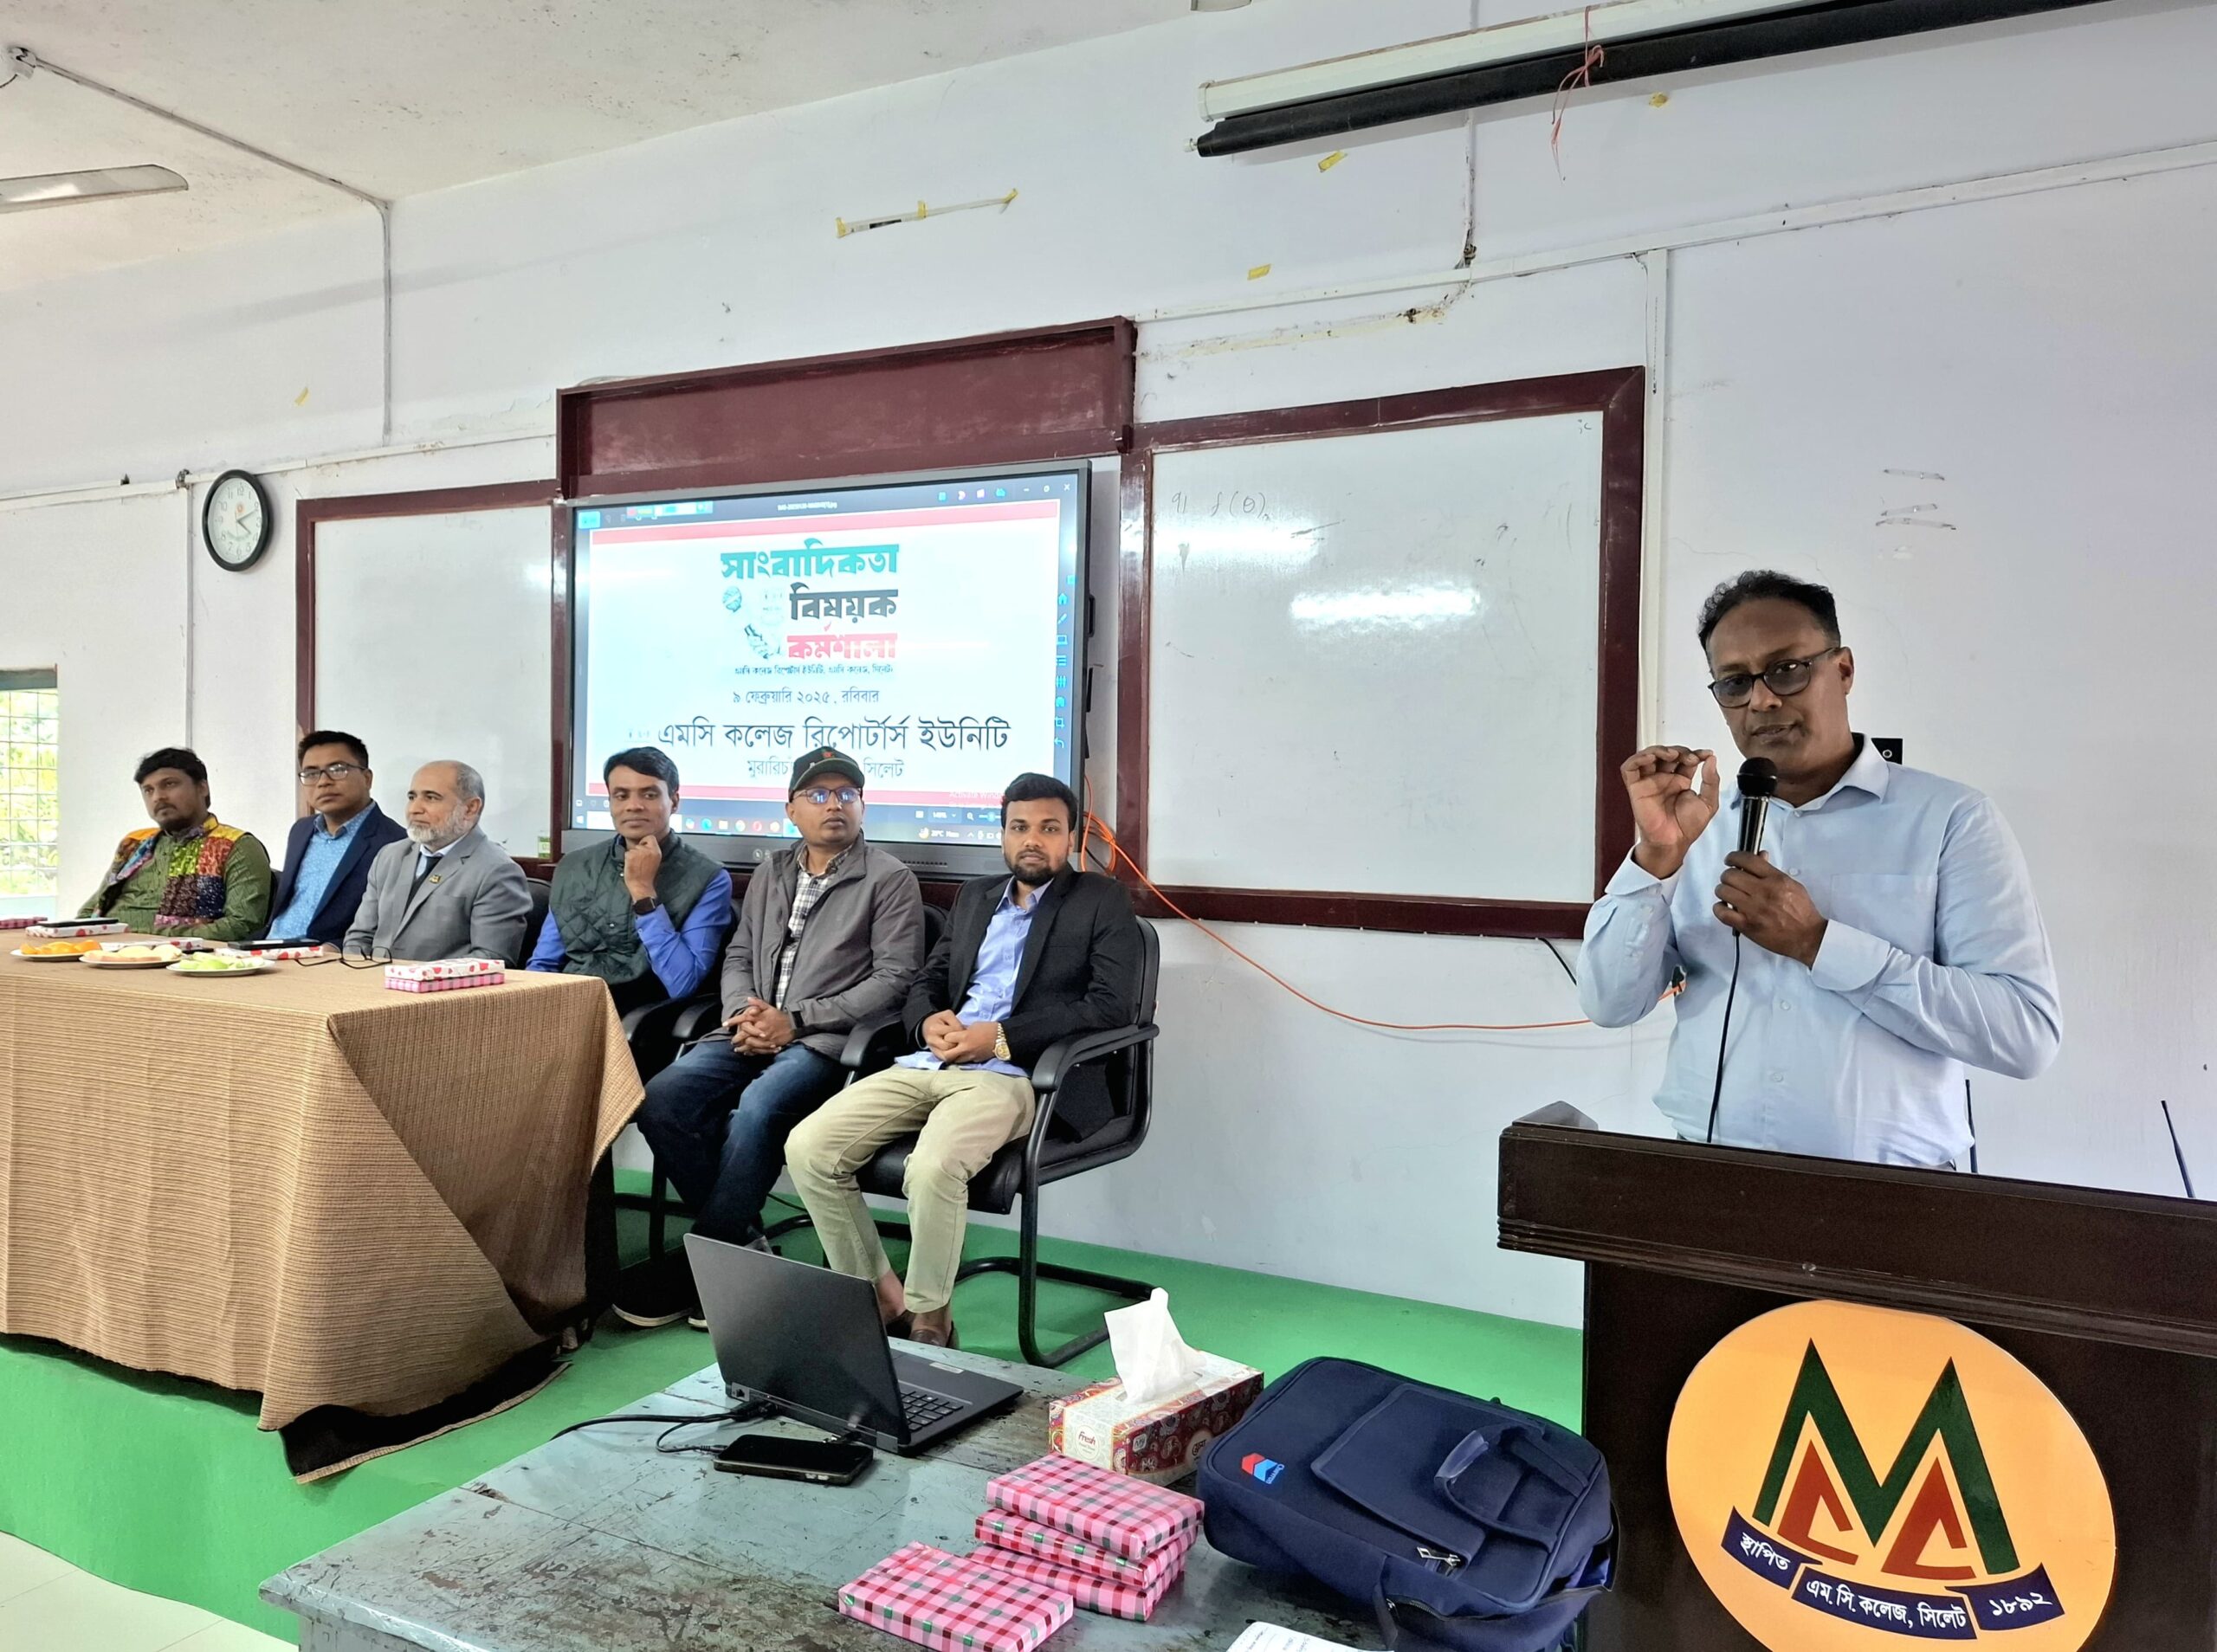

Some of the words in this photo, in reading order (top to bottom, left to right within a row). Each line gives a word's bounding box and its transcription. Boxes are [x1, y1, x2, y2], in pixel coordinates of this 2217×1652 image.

[721, 538, 899, 579] সাংবাদিকতা
[789, 581, 898, 623] বিষয়ক
[786, 622, 897, 659] কর্মশালা
[841, 686, 880, 703] রবিবার
[658, 716, 715, 748] এমসি
[722, 724, 795, 749] কলেজ
[803, 714, 911, 750] রিপোর্টার্স
[917, 716, 1012, 752] ইউনিটি
[863, 756, 904, 778] সিলেট
[1078, 1430, 1096, 1446] Fresh
[1740, 1532, 1791, 1571] স্থাপিত
[1859, 1596, 1913, 1629] কলেজ,
[1916, 1604, 1967, 1629] সিলেট
[1991, 1591, 2053, 1617] ১৮৯২
